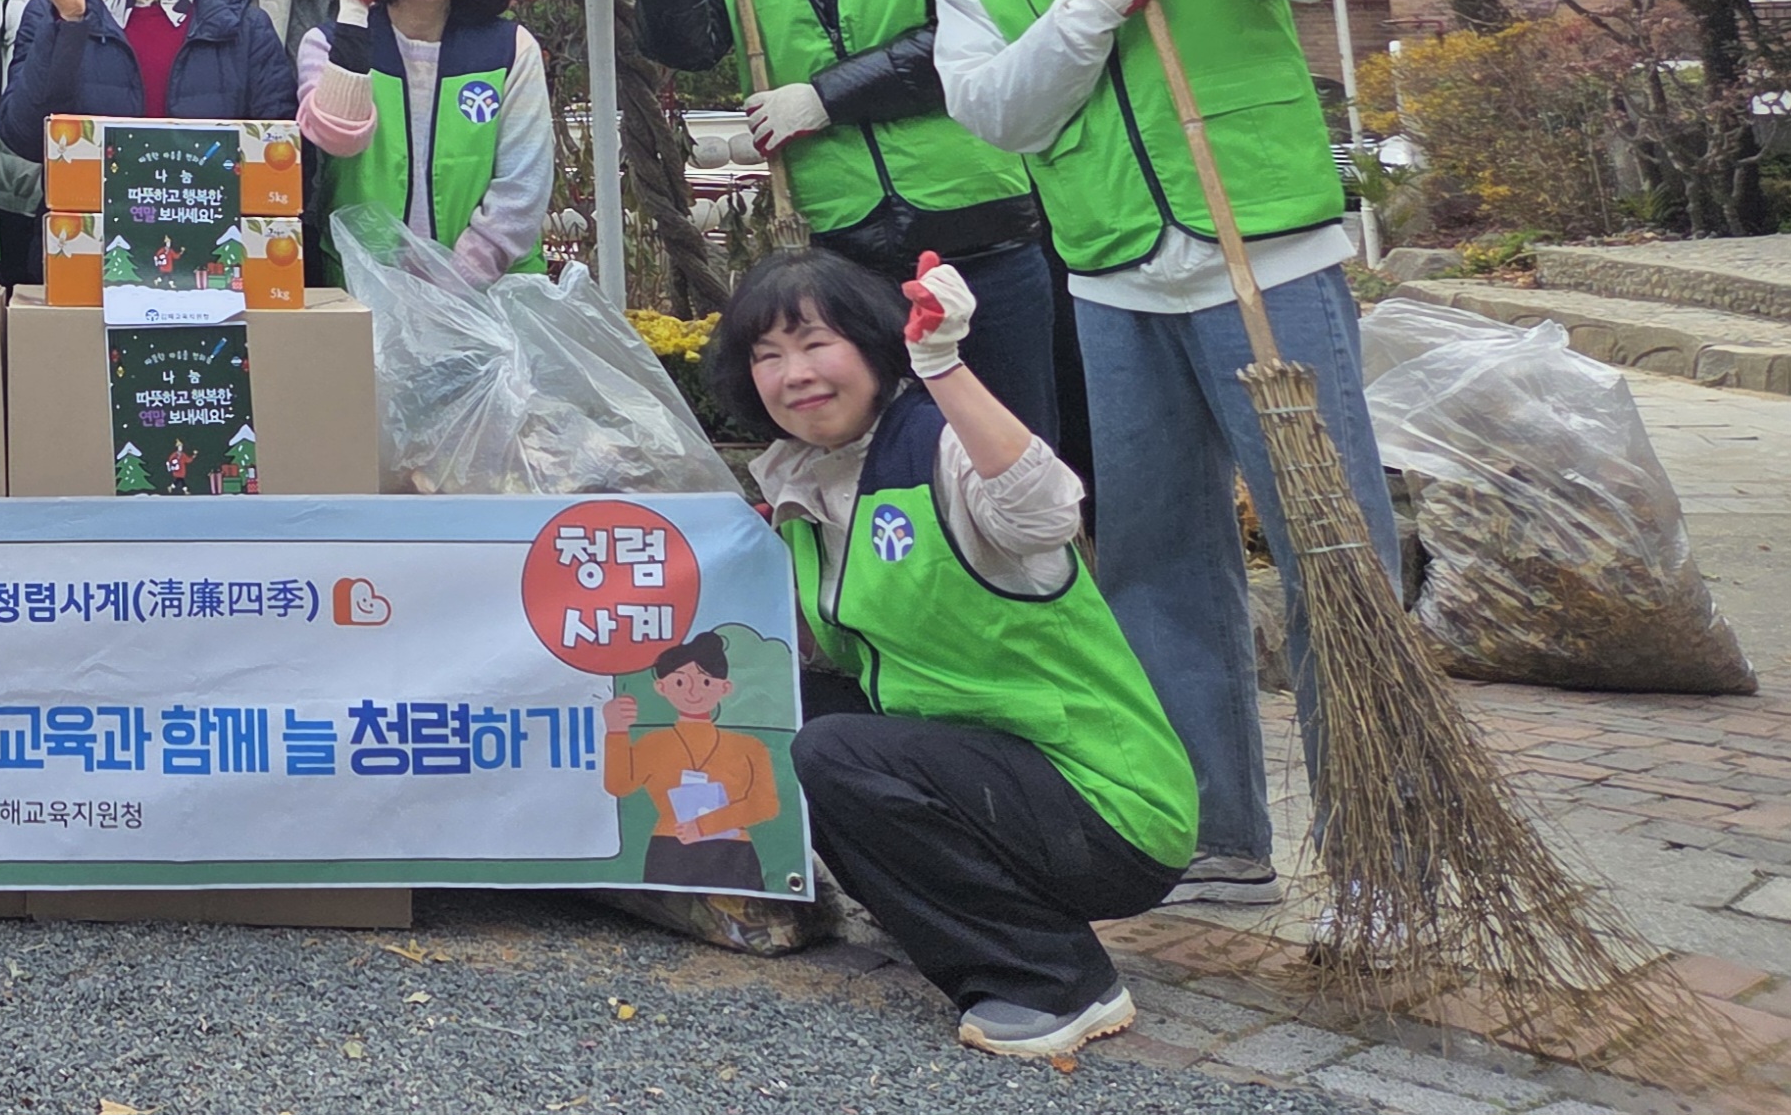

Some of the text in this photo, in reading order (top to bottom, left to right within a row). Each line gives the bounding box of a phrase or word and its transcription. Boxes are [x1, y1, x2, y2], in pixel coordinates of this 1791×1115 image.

[128, 188, 223, 206] 따뜻하고 행복한
[268, 191, 289, 204] 5kg
[130, 206, 157, 223] 연말
[270, 287, 291, 300] 5kg
[136, 388, 232, 407] 따뜻하고 행복한
[139, 410, 166, 427] 연말
[554, 526, 666, 589] 청렴
[562, 604, 674, 648] 사계
[161, 705, 269, 775] 함께
[282, 708, 338, 775] 늘
[348, 699, 597, 776] 청렴하기!
